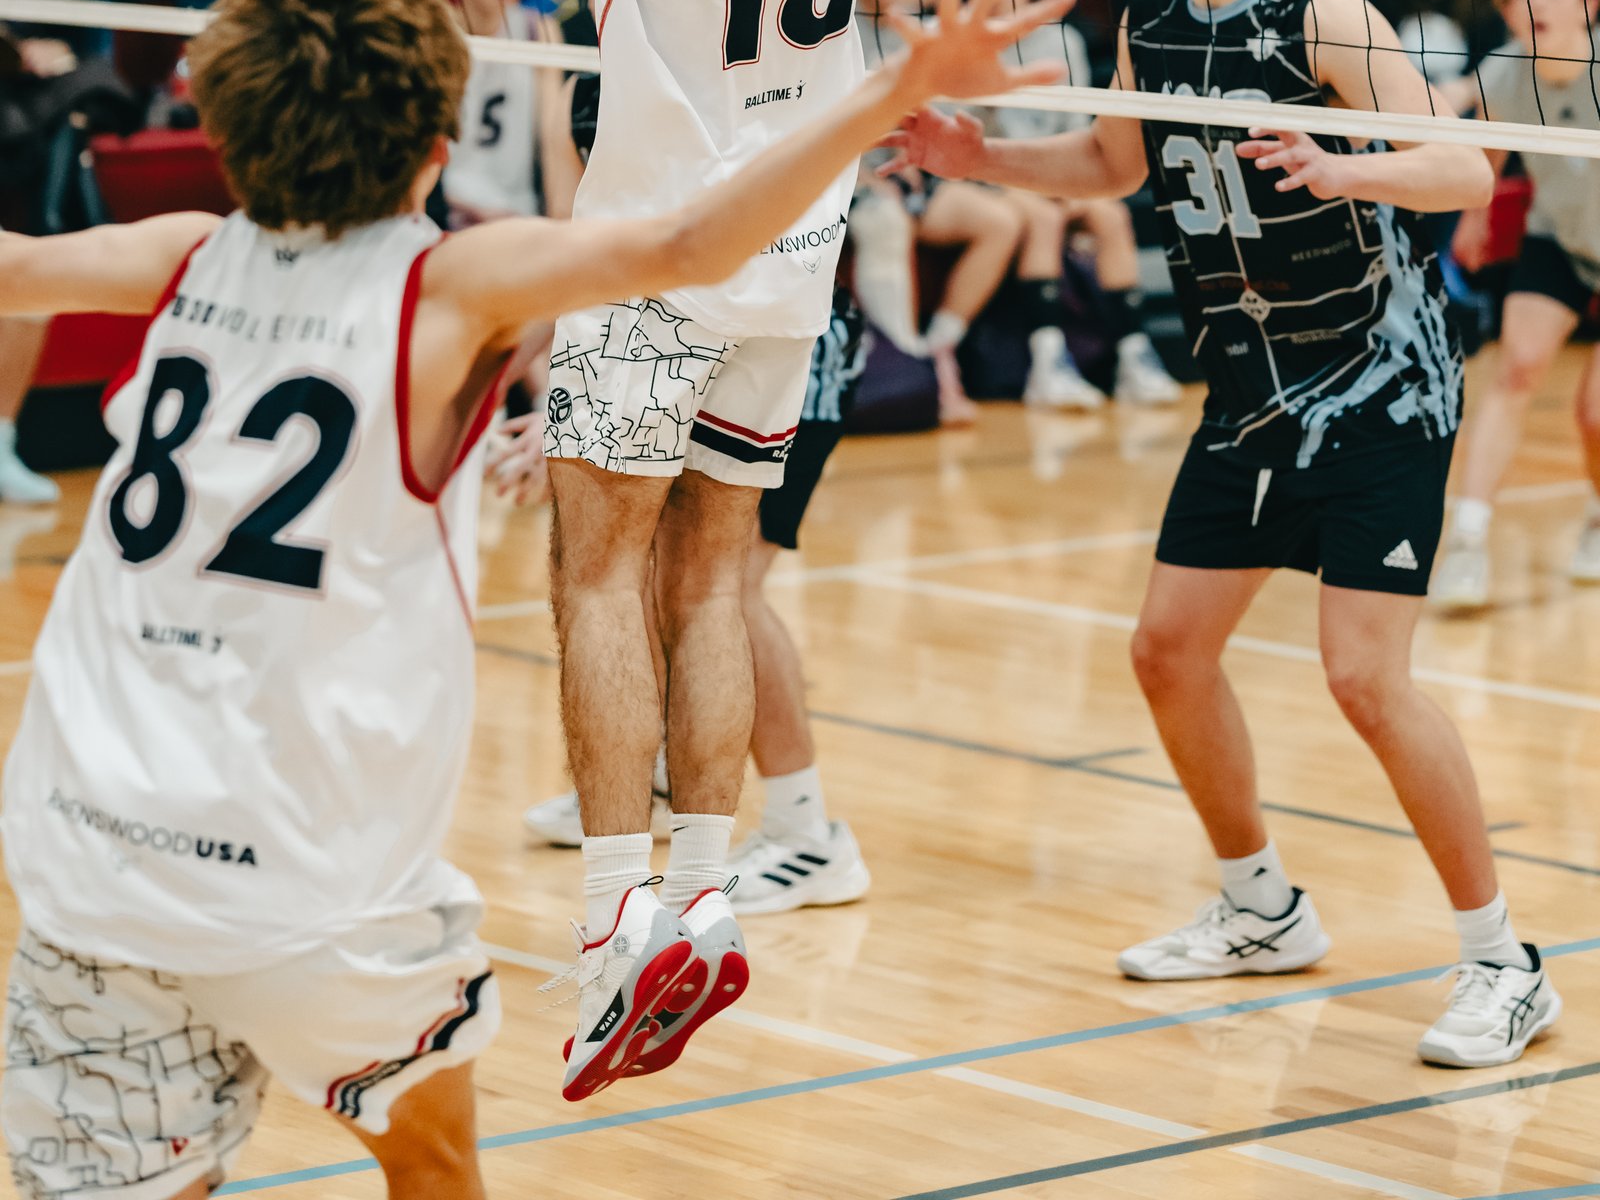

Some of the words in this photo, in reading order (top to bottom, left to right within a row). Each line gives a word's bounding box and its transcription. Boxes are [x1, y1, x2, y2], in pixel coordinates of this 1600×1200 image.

[744, 86, 793, 110] BALLTIME
[1162, 135, 1262, 238] 31
[103, 347, 364, 600] 82
